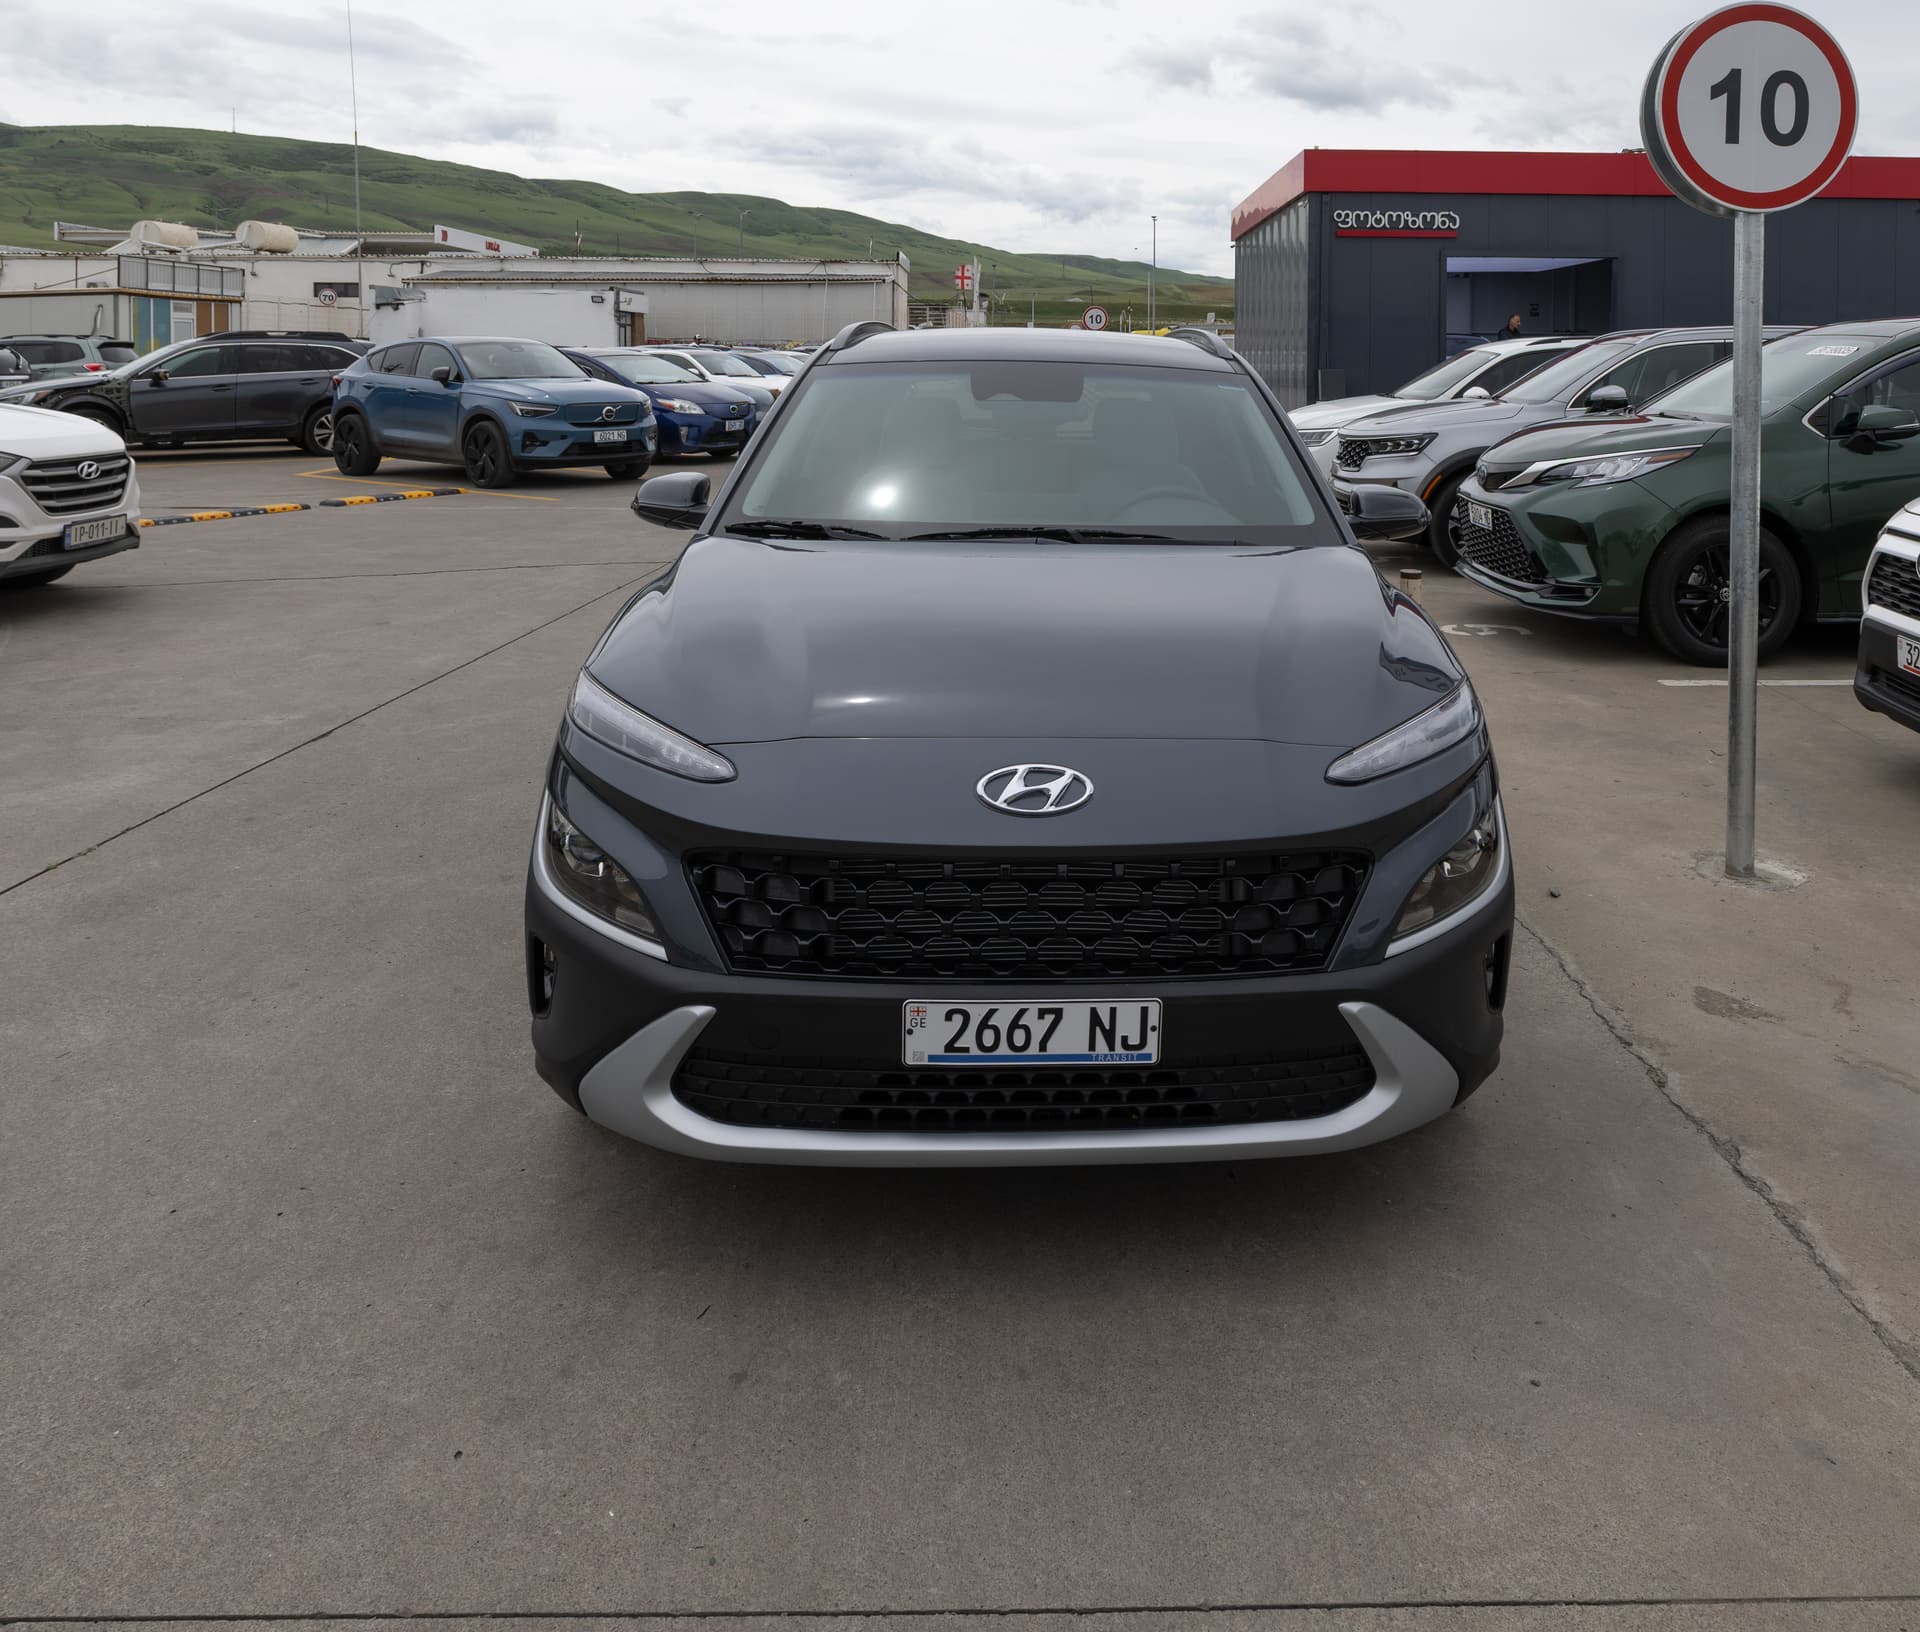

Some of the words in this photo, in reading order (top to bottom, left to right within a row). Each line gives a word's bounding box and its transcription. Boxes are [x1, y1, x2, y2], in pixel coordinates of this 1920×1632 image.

[1710, 68, 1809, 146] 10
[1333, 210, 1459, 228] ფოტოზონა
[322, 294, 334, 302] 70
[1089, 314, 1102, 324] 10
[910, 1018, 927, 1028] GE
[944, 1007, 1063, 1053] 2667
[1088, 1006, 1149, 1052] NJ
[1091, 1054, 1138, 1062] TRANSIT
